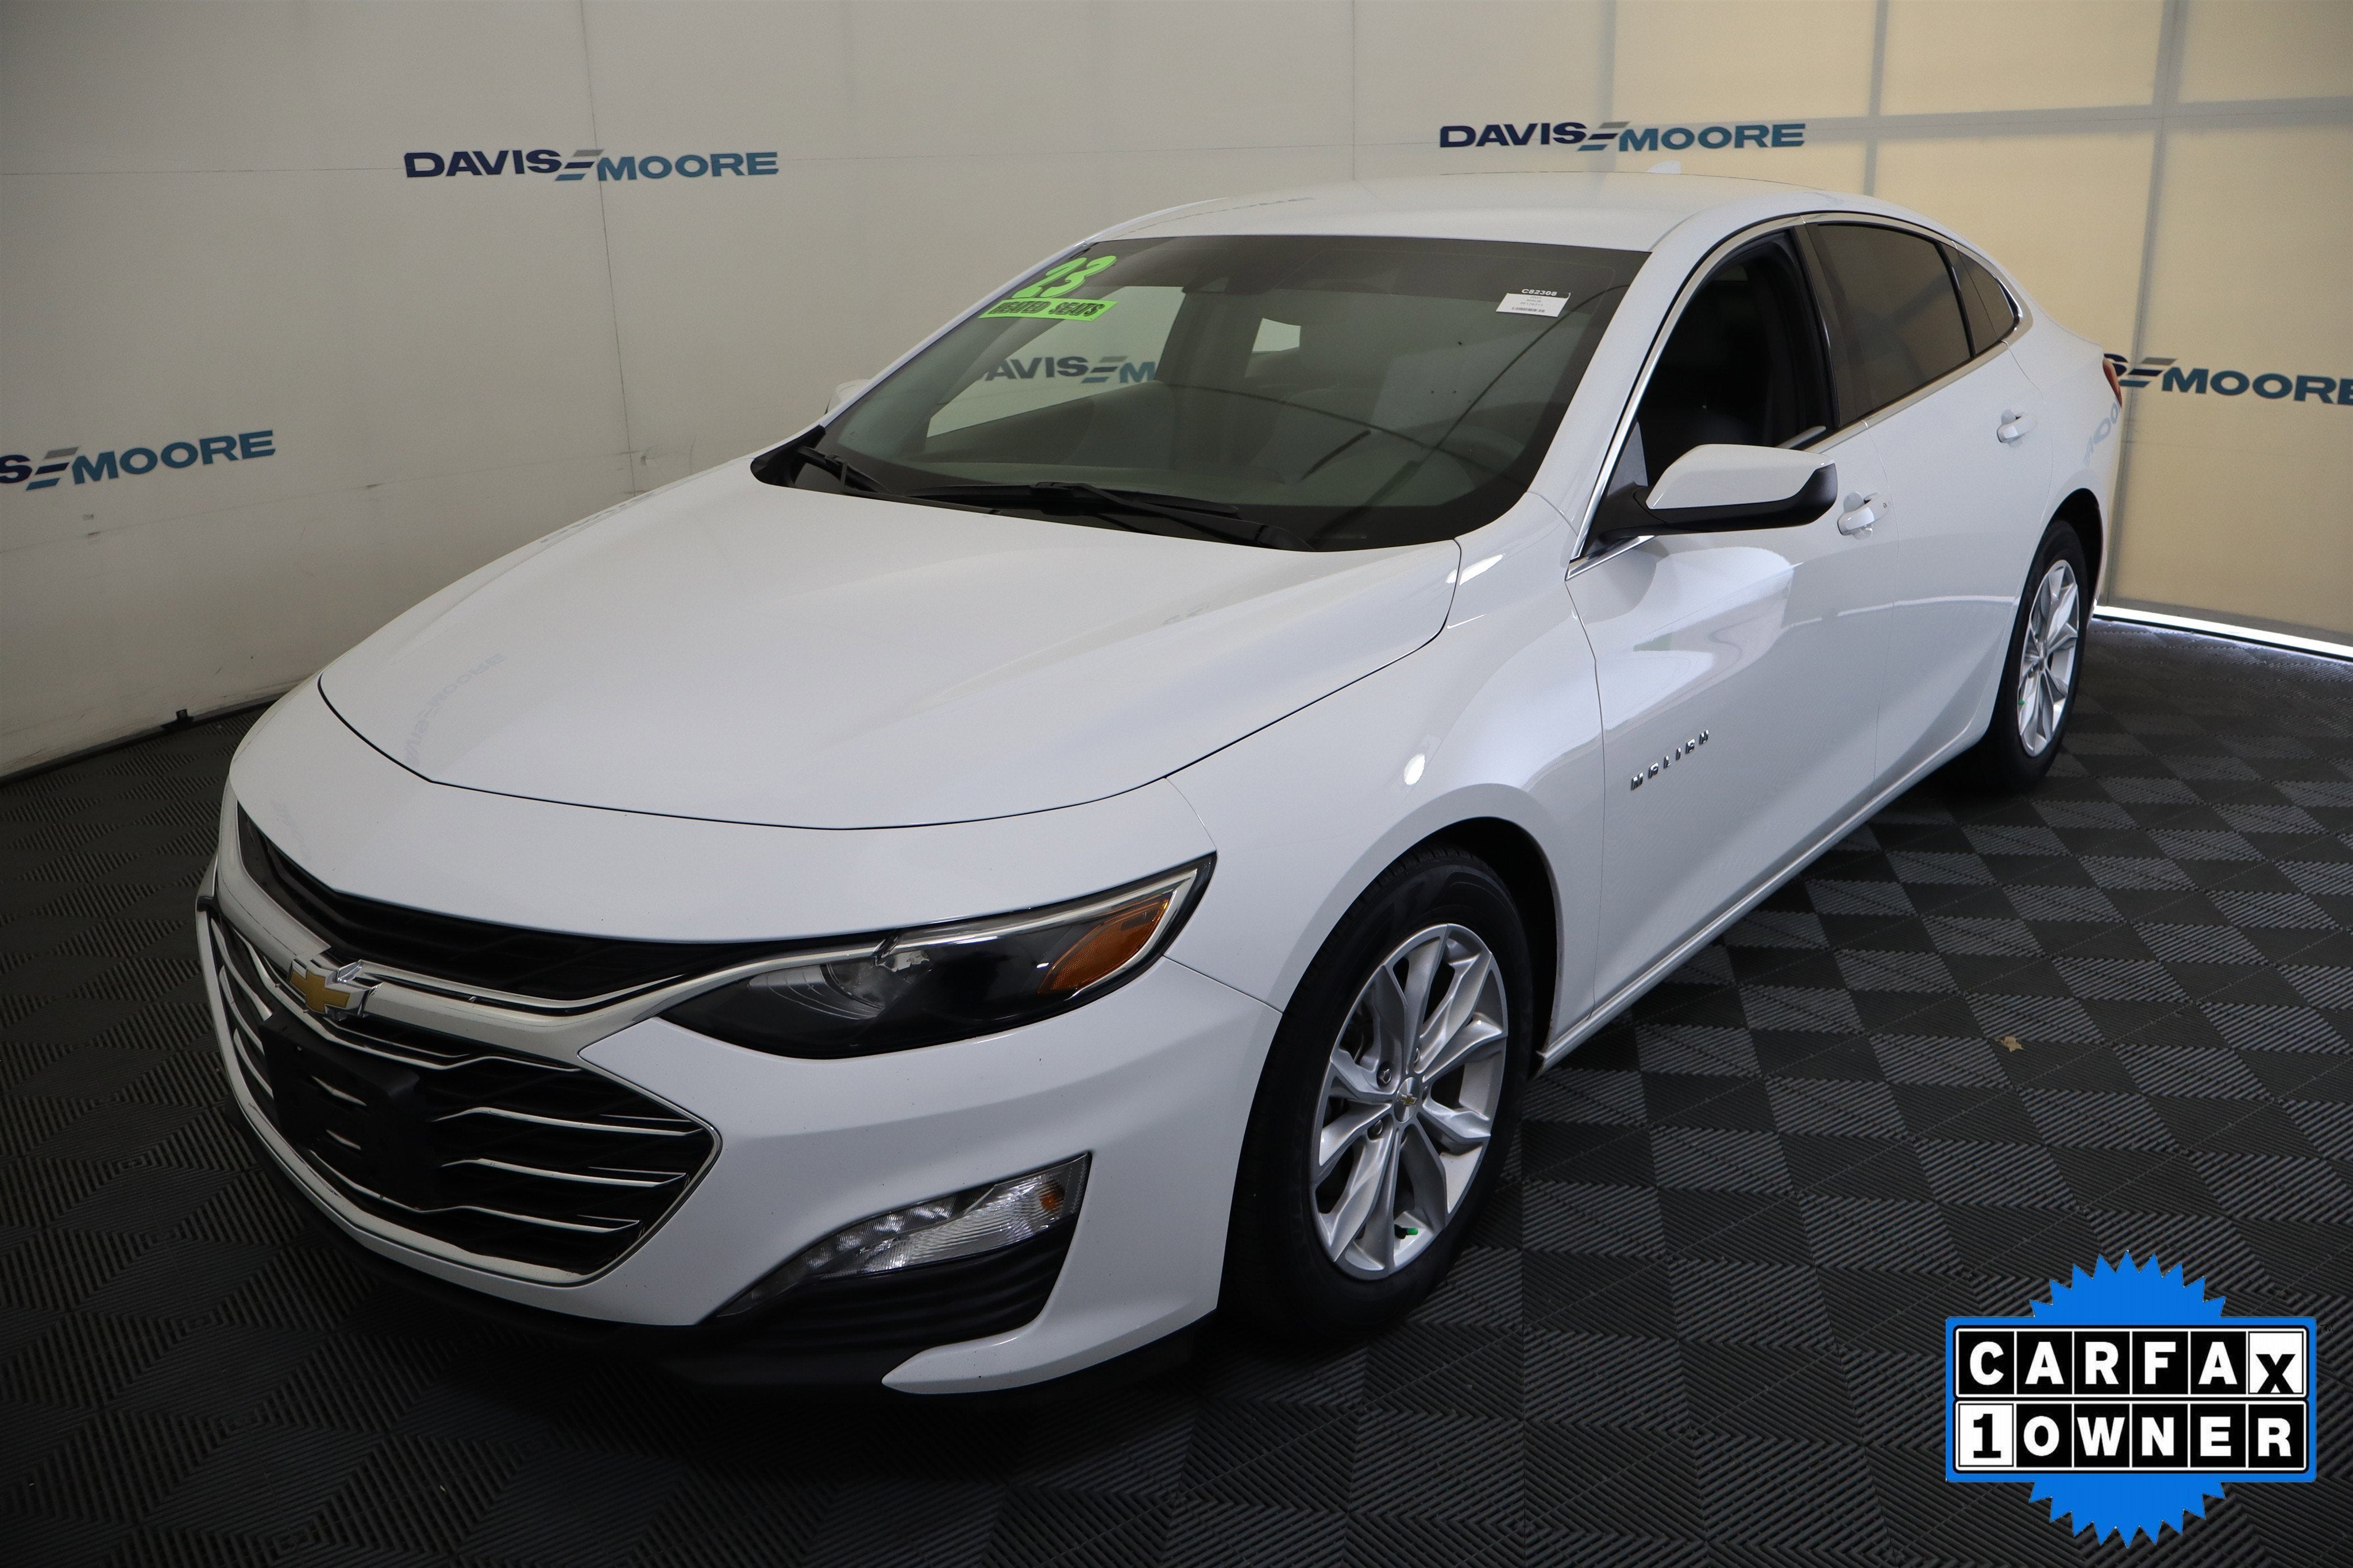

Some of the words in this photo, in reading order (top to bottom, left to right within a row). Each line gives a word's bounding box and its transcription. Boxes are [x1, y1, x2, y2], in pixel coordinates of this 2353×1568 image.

[1439, 121, 1588, 148] DAVIS
[1618, 123, 1807, 152] MOORE
[403, 149, 563, 177] DAVIS
[596, 152, 780, 181] MOORE
[1012, 254, 1117, 299] 23
[988, 300, 1051, 314] HEATED
[1048, 302, 1106, 316] SEATS
[979, 356, 1089, 381] AVIS
[71, 429, 276, 485] MOORE
[1631, 729, 1708, 790] MALIBU
